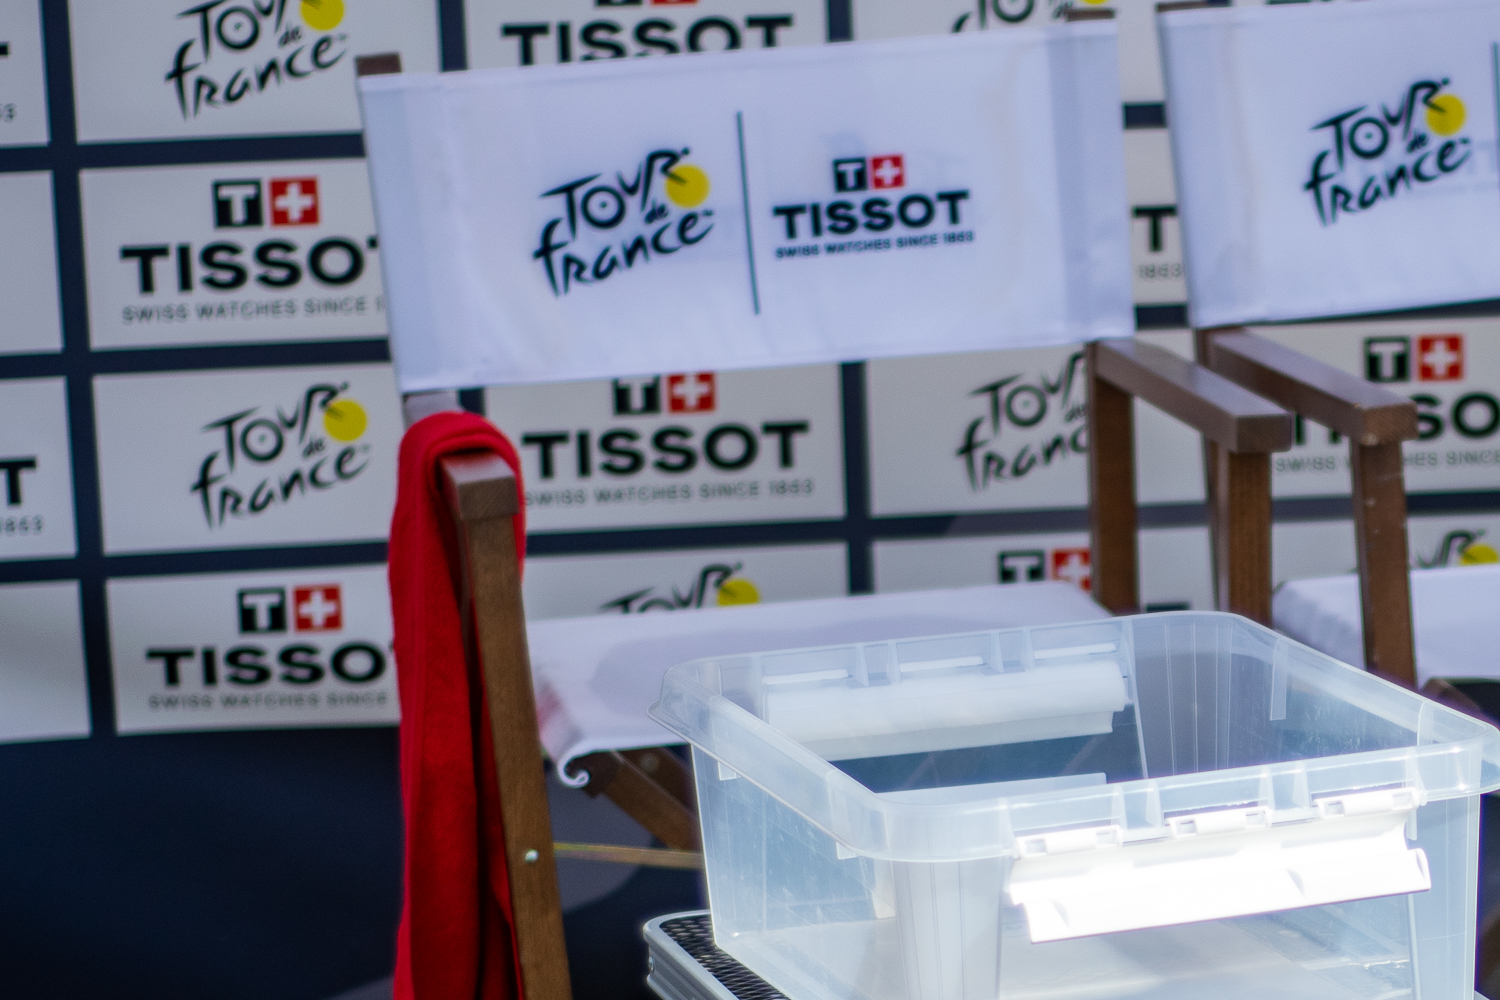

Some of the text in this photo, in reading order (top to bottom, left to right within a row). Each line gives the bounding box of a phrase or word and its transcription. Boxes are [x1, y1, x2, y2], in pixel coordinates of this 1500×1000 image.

[502, 15, 793, 64] TISSOT
[772, 189, 969, 239] TISSOT
[120, 236, 378, 294] TISSO
[533, 211, 714, 297] france
[775, 230, 974, 259] SWISS WATCHES SINCE 1863
[122, 302, 189, 325] SWISS
[195, 299, 296, 321] WATCHES
[304, 296, 367, 314] SINCE
[521, 421, 810, 479] TISSOT
[956, 416, 1087, 492] franc
[594, 485, 691, 504] WATCHES
[700, 480, 759, 499] SINCE
[146, 641, 388, 687] TISSO
